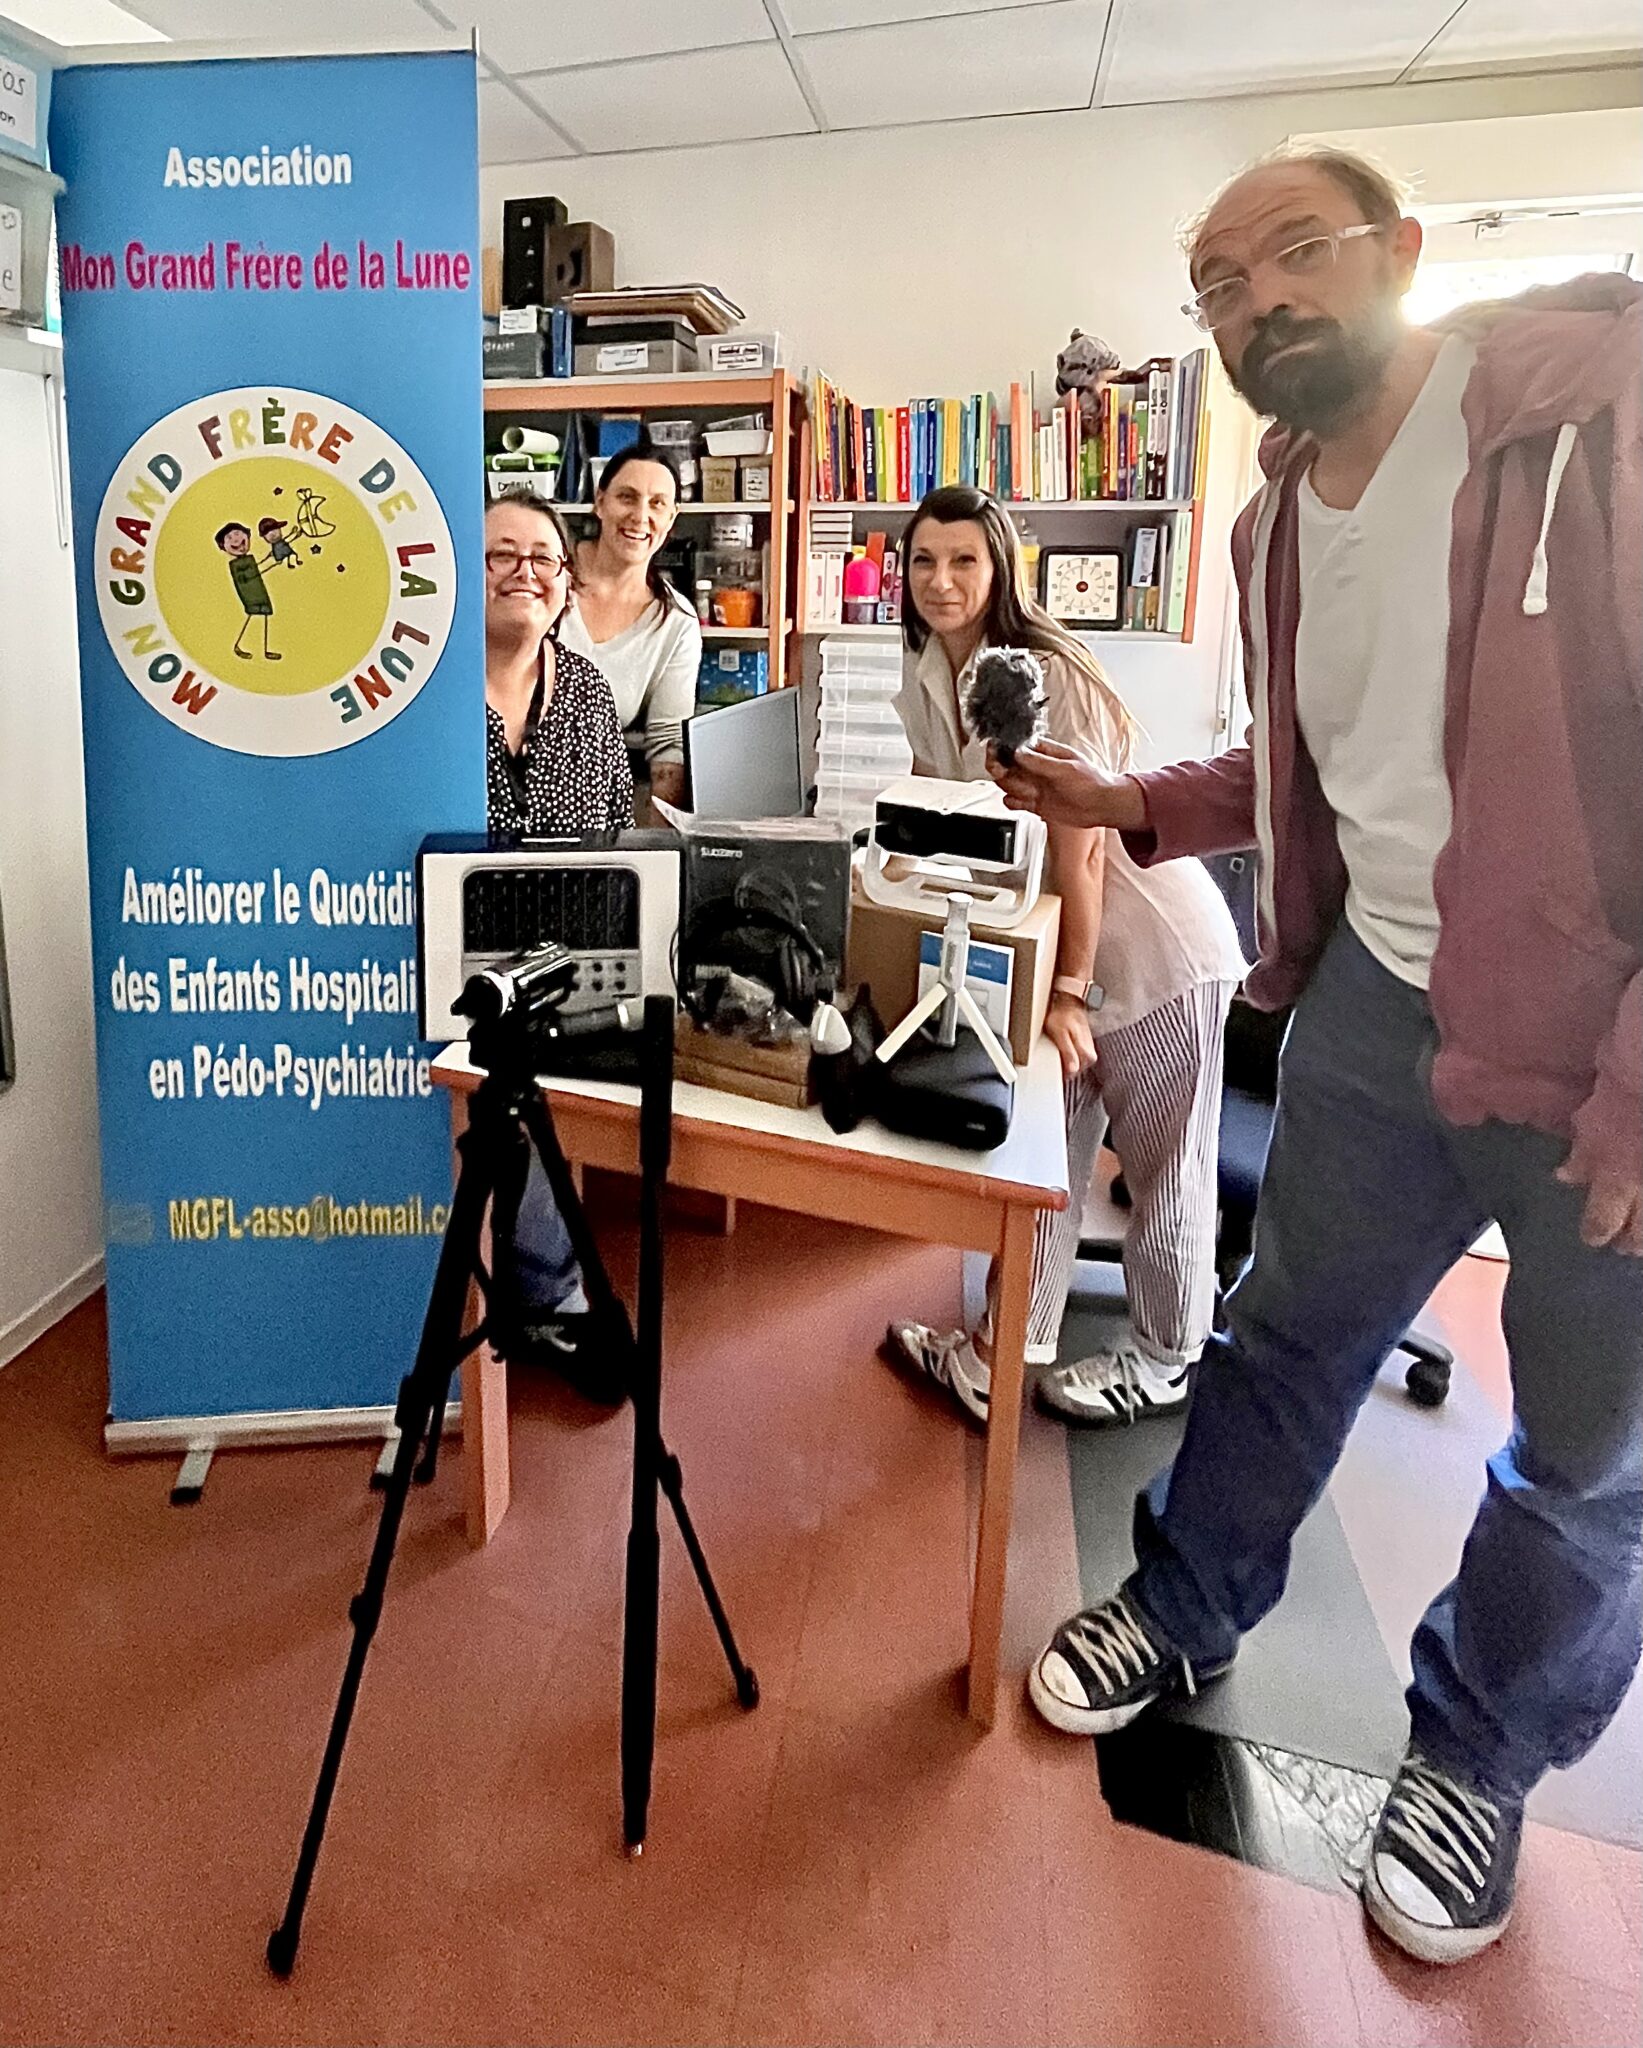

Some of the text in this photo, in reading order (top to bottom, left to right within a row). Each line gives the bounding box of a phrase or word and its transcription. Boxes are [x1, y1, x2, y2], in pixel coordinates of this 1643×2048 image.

[164, 145, 352, 187] Association
[62, 240, 471, 290] Mon Grand Frère de la Lune
[110, 397, 437, 723] MON GRAND FRÈRE DE LA LUNE
[122, 867, 266, 925] Améliorer
[273, 868, 301, 925] le
[111, 956, 161, 1013] des
[169, 957, 280, 1013] Enfants
[150, 1043, 433, 1111] en Pédo-Psychiatrie
